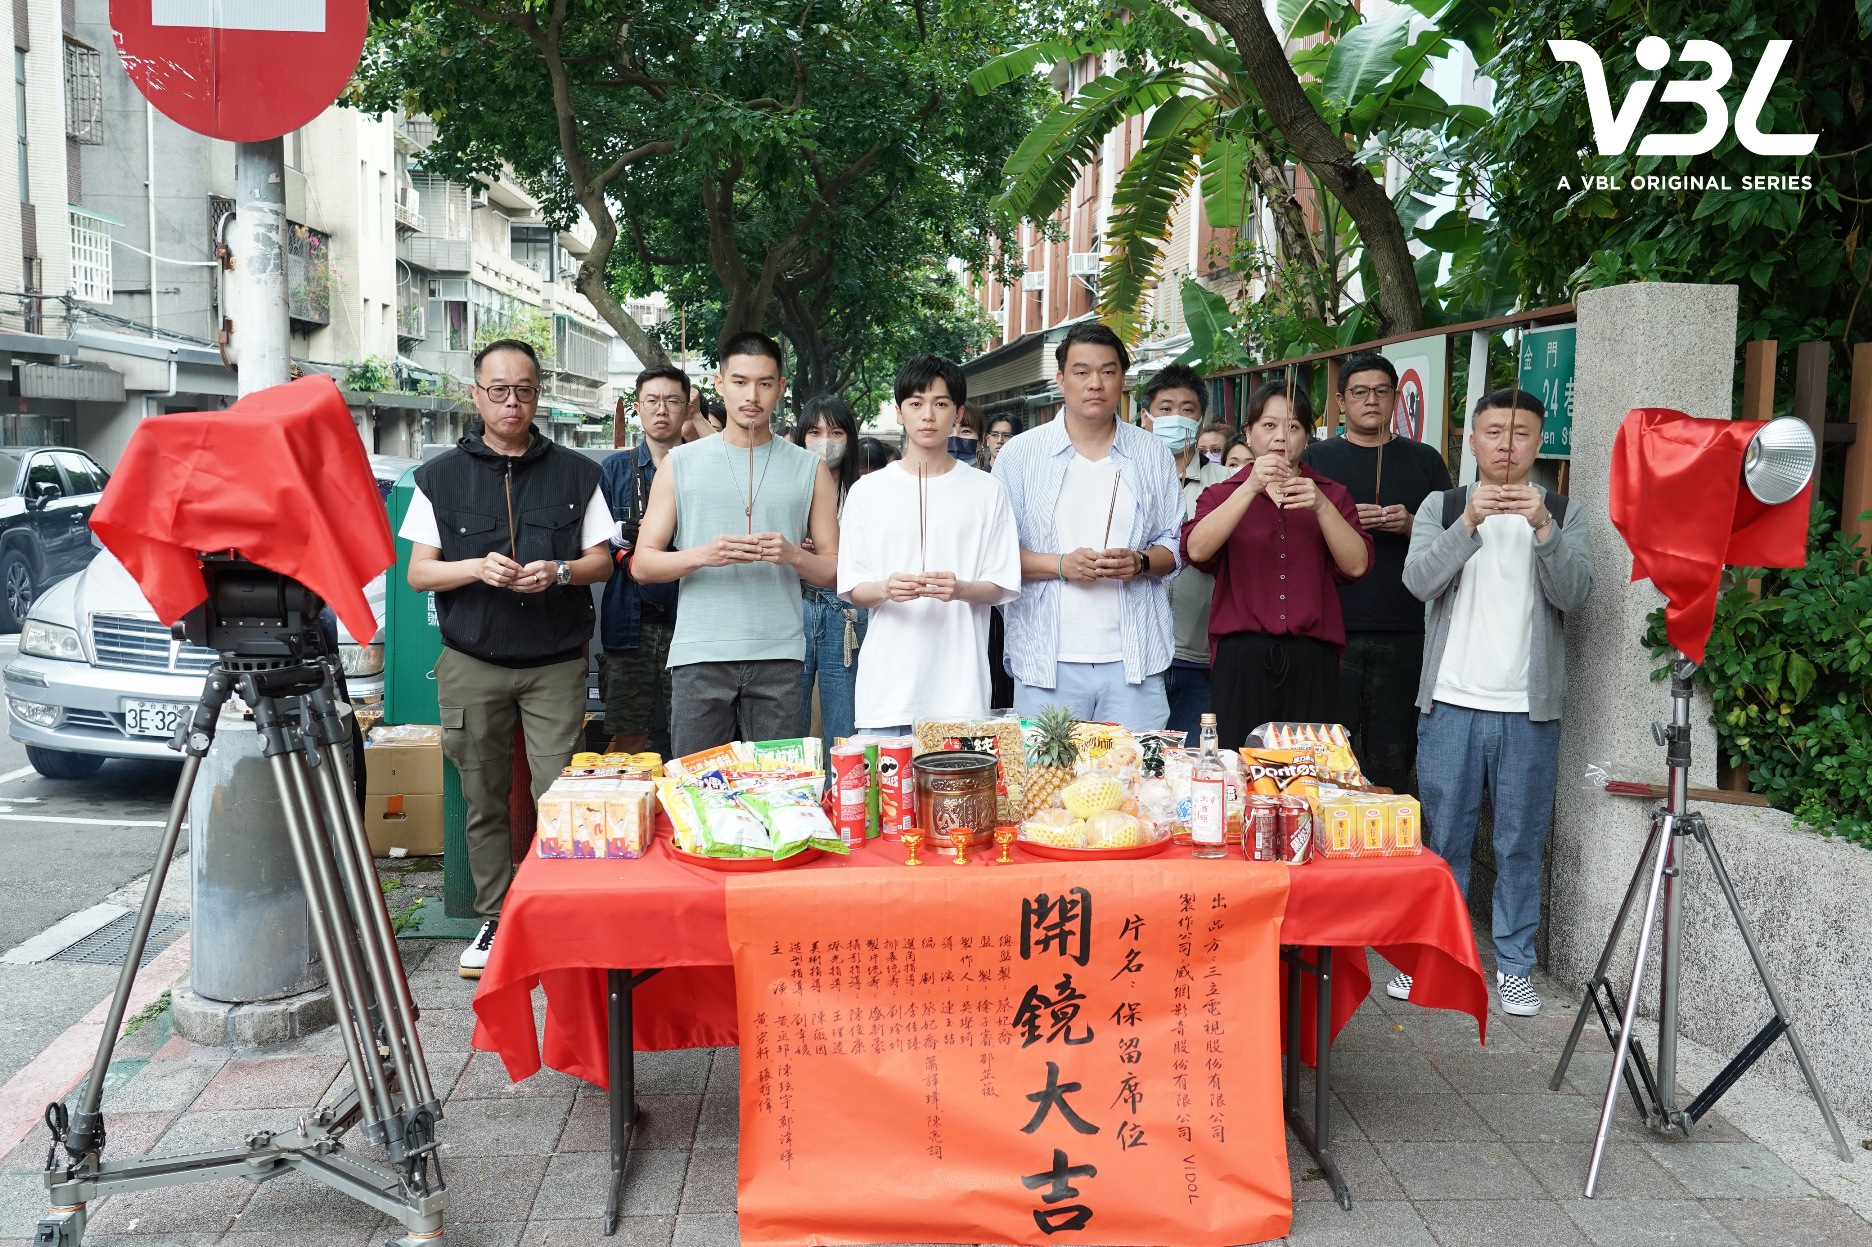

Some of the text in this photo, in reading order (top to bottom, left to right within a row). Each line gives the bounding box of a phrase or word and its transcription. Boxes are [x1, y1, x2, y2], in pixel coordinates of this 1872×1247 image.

[1249, 764, 1317, 781] Doritos
[1012, 887, 1100, 1235] 開鏡大吉
[1182, 1154, 1200, 1205] VIDOL
